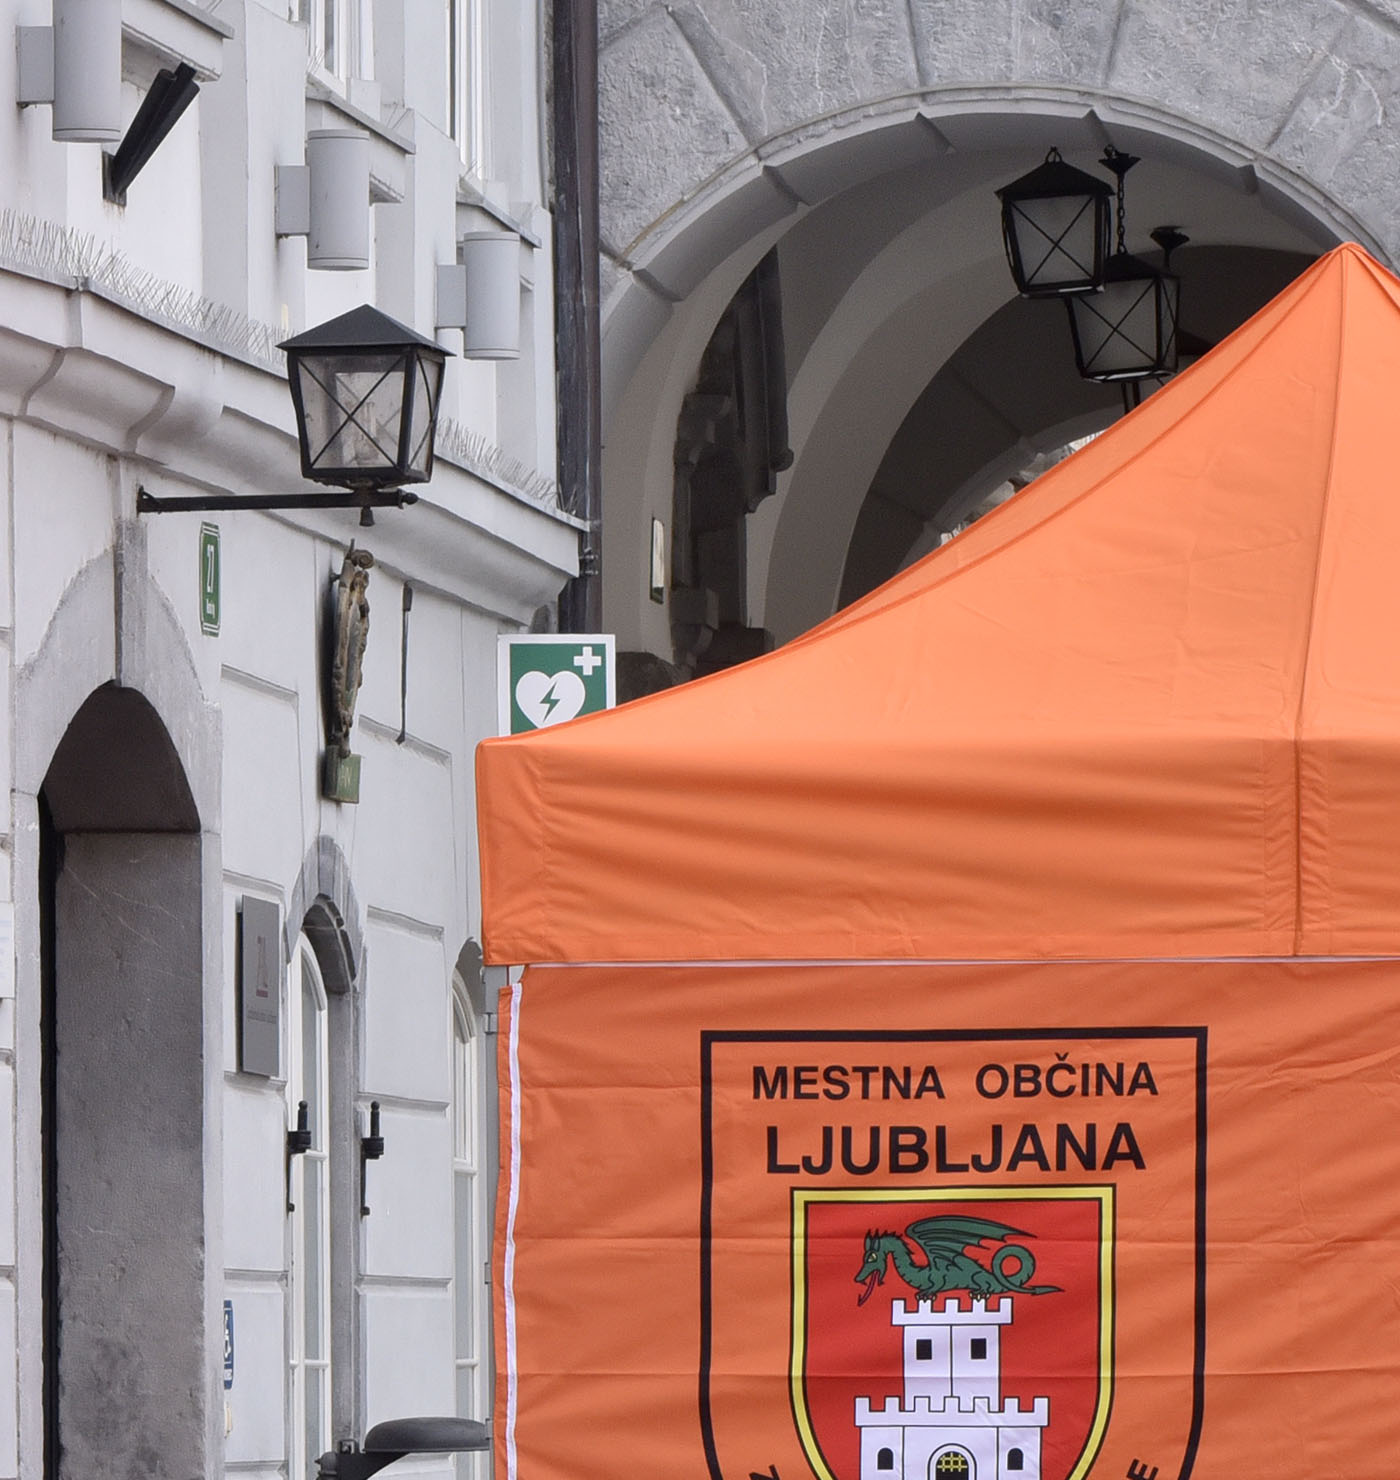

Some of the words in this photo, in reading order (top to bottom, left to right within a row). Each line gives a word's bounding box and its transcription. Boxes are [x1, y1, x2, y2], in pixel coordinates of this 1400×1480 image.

[752, 1065, 946, 1100] MESTNA
[975, 1052, 1159, 1099] OBČINA
[765, 1122, 1147, 1175] LJUBLJANA
